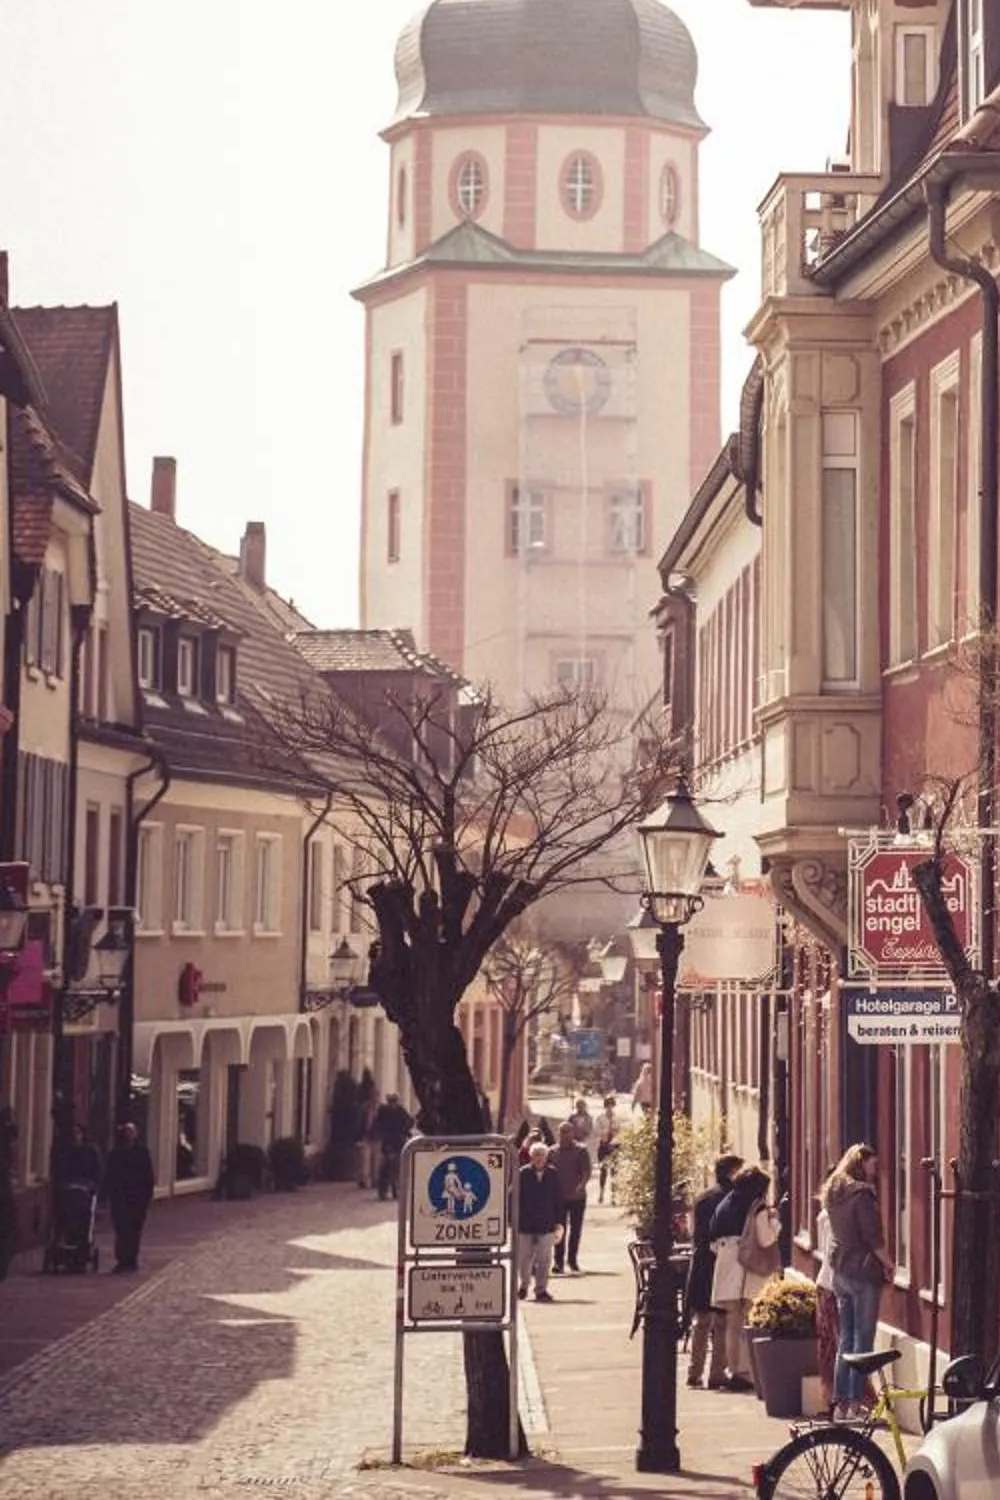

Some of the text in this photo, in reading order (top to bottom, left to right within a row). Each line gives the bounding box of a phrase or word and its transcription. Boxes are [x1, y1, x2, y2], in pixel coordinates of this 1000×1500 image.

[866, 914, 921, 935] engel
[855, 998, 940, 1015] Hotelgarage
[857, 1022, 961, 1037] beraten & reisen
[435, 1223, 483, 1241] ZONE
